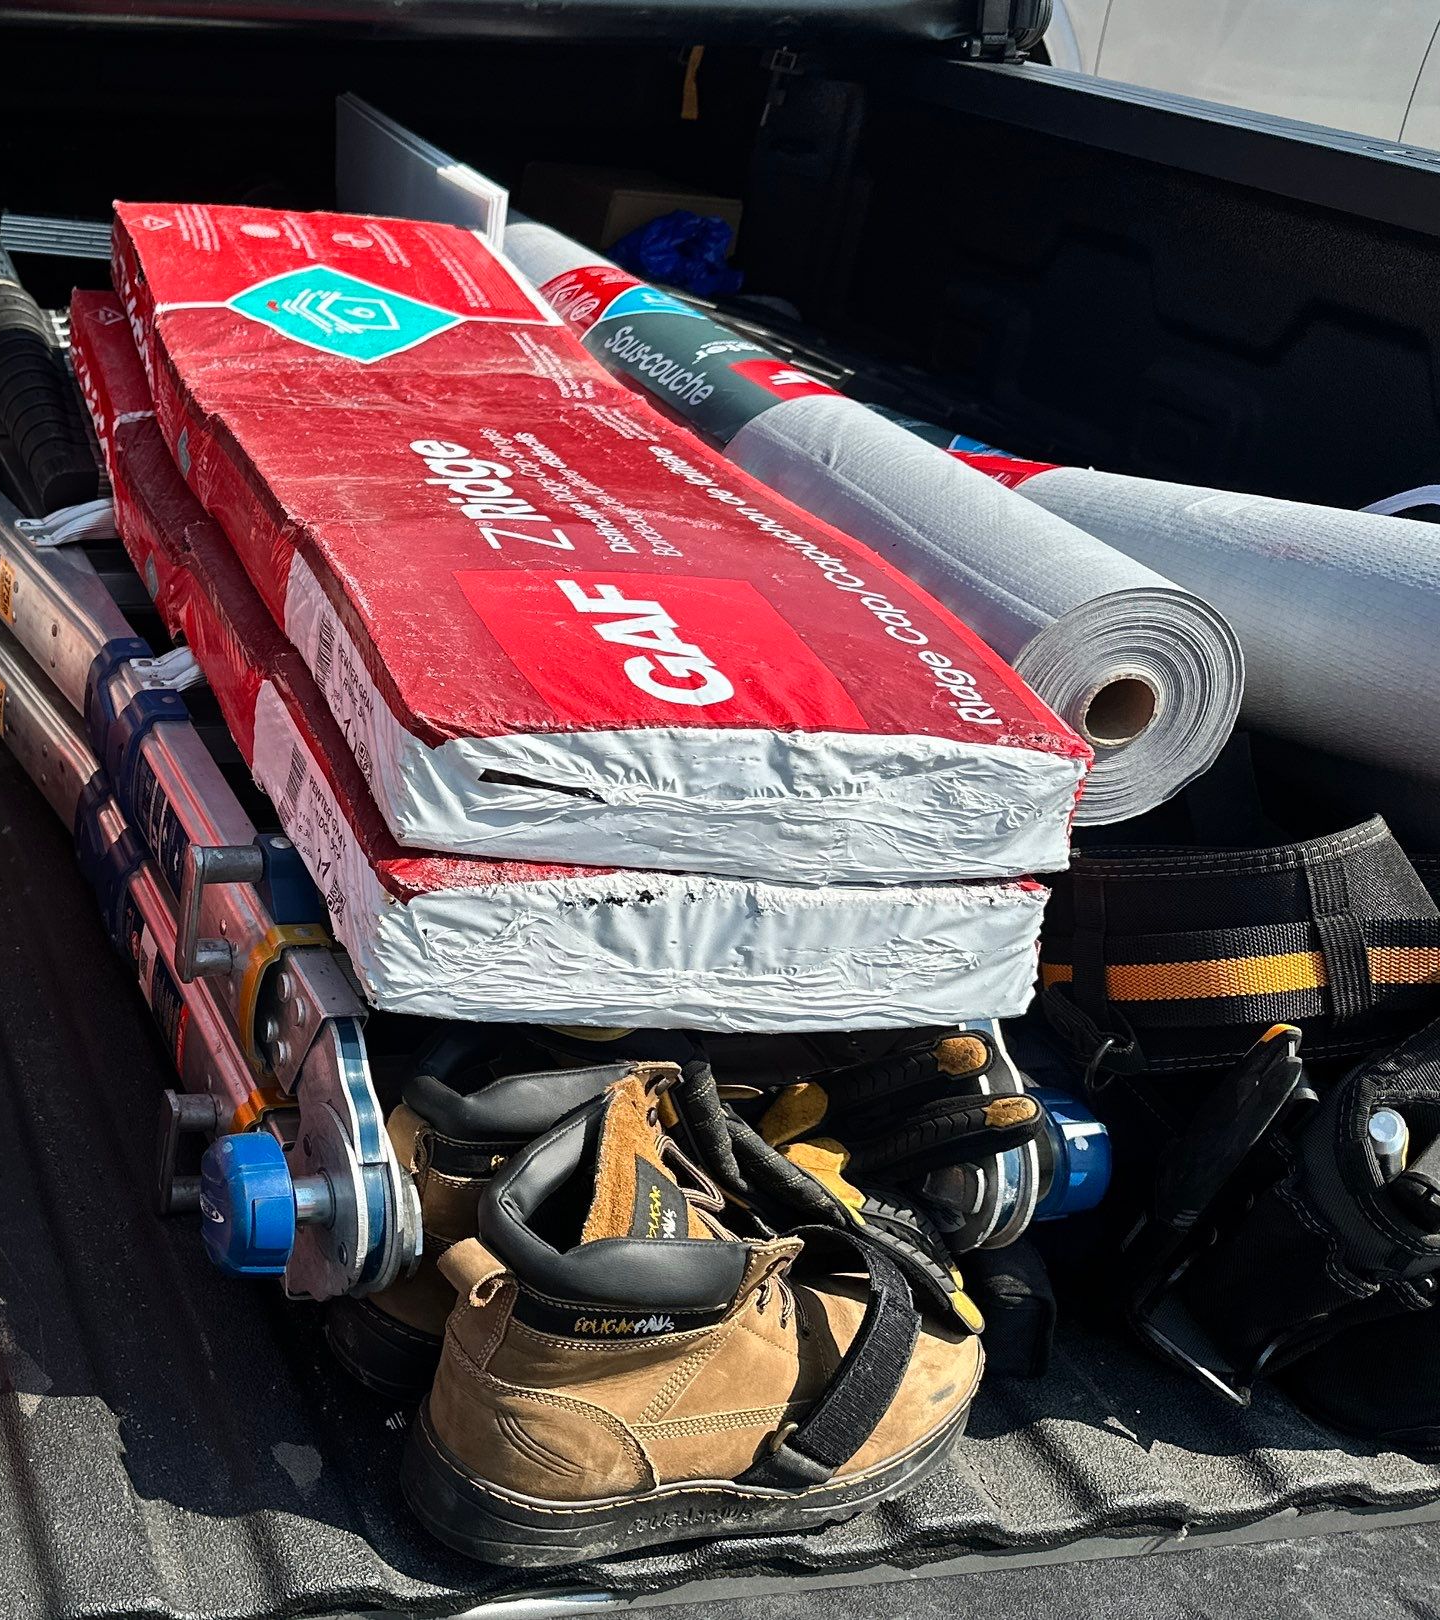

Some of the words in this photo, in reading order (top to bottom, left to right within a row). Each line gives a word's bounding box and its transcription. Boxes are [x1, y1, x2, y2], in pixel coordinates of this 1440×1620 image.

[603, 325, 715, 406] Sous-couche
[409, 439, 553, 522] Ridge
[513, 457, 546, 478] Cap
[537, 477, 582, 503] Ridge
[706, 486, 746, 506] de
[570, 503, 640, 554] Distinctive
[554, 579, 735, 706] GAF
[918, 649, 1004, 726] Ridge
[309, 774, 333, 821] PEWTER
